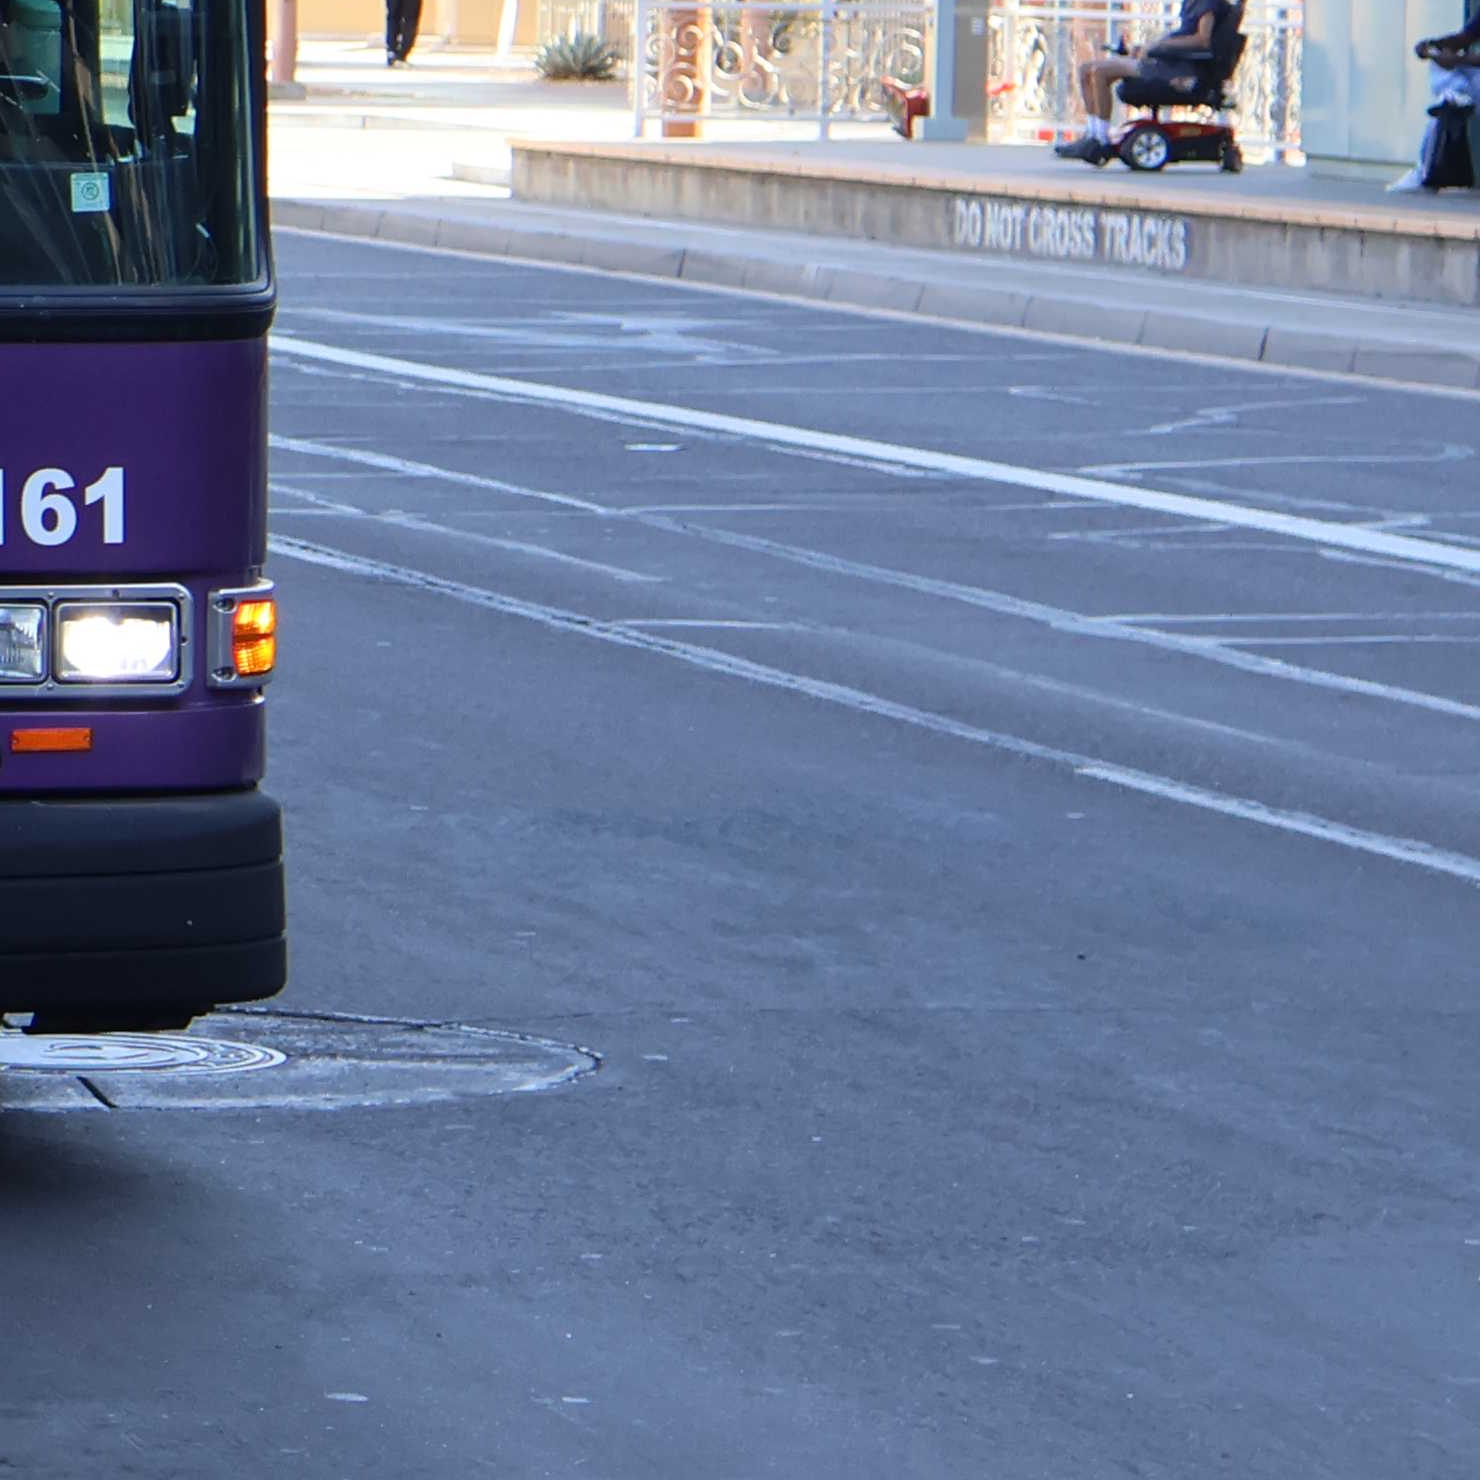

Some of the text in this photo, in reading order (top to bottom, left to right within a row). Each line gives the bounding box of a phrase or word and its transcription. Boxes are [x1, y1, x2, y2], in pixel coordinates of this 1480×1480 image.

[954, 199, 1187, 270] DO NOT CROSS TRACKS
